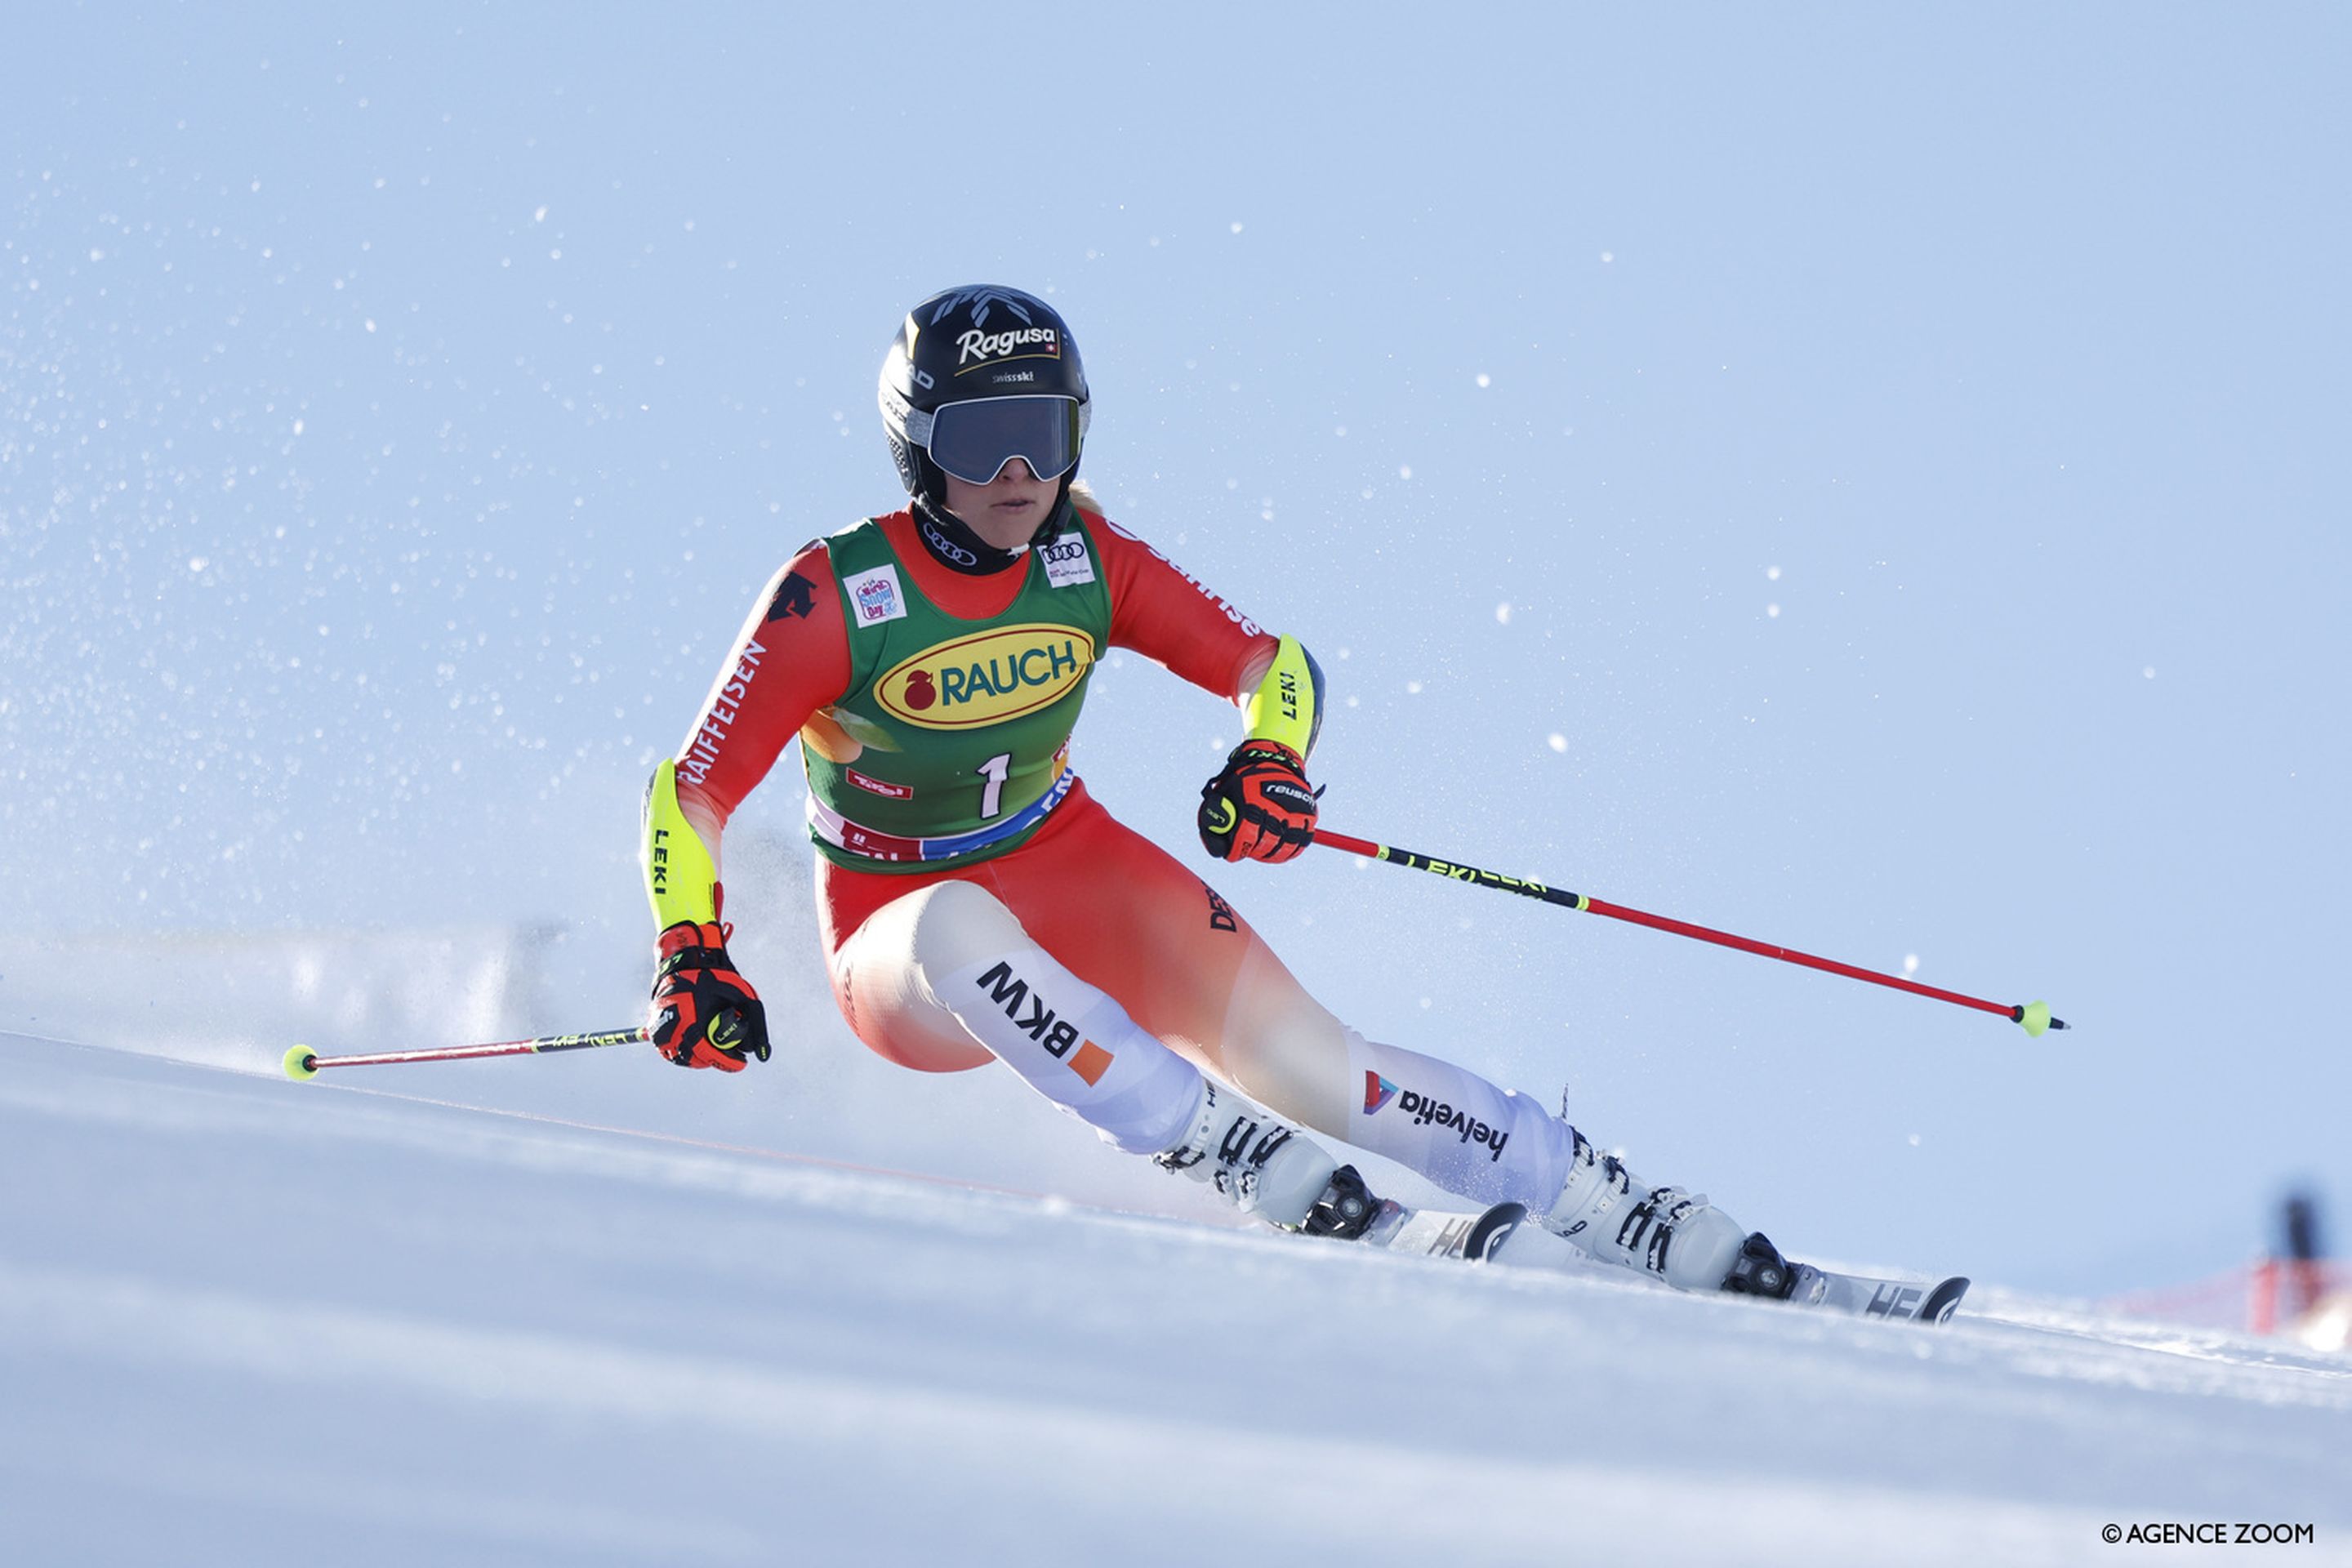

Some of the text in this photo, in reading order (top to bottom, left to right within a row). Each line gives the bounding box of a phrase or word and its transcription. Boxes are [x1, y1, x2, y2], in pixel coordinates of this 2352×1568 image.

[956, 327, 1055, 364] Ragusa
[941, 640, 1076, 706] RAUCH
[1280, 672, 1297, 720] LEKI
[677, 639, 768, 785] RAIFFEISEN
[976, 751, 1012, 821] 1
[653, 829, 669, 895] LEKI
[976, 961, 1080, 1058] BKW
[1399, 1090, 1508, 1162] helvetia
